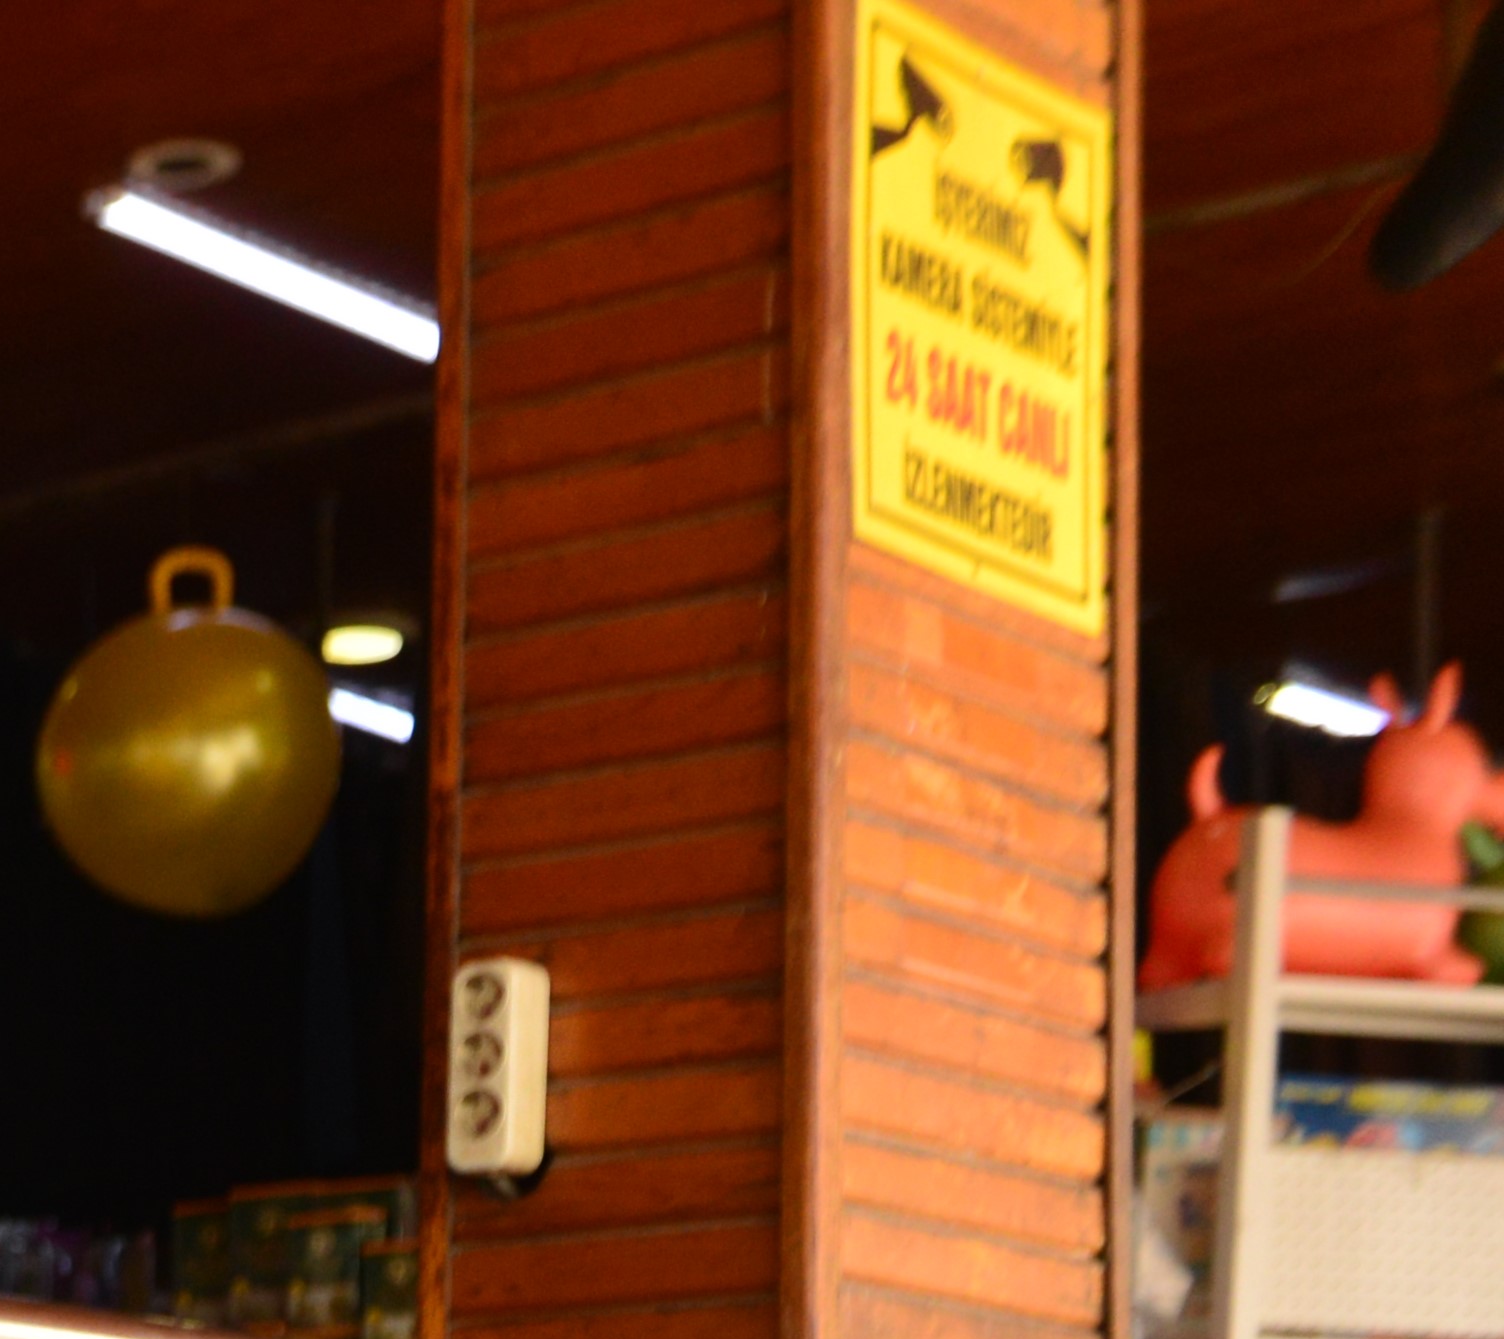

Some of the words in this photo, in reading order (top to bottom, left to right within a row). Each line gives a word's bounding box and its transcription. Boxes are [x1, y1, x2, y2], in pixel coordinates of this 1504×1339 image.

[881, 232, 963, 318] KAMERA
[886, 329, 918, 412] 24
[926, 345, 992, 443] SAAT
[998, 381, 1070, 480] CANLI
